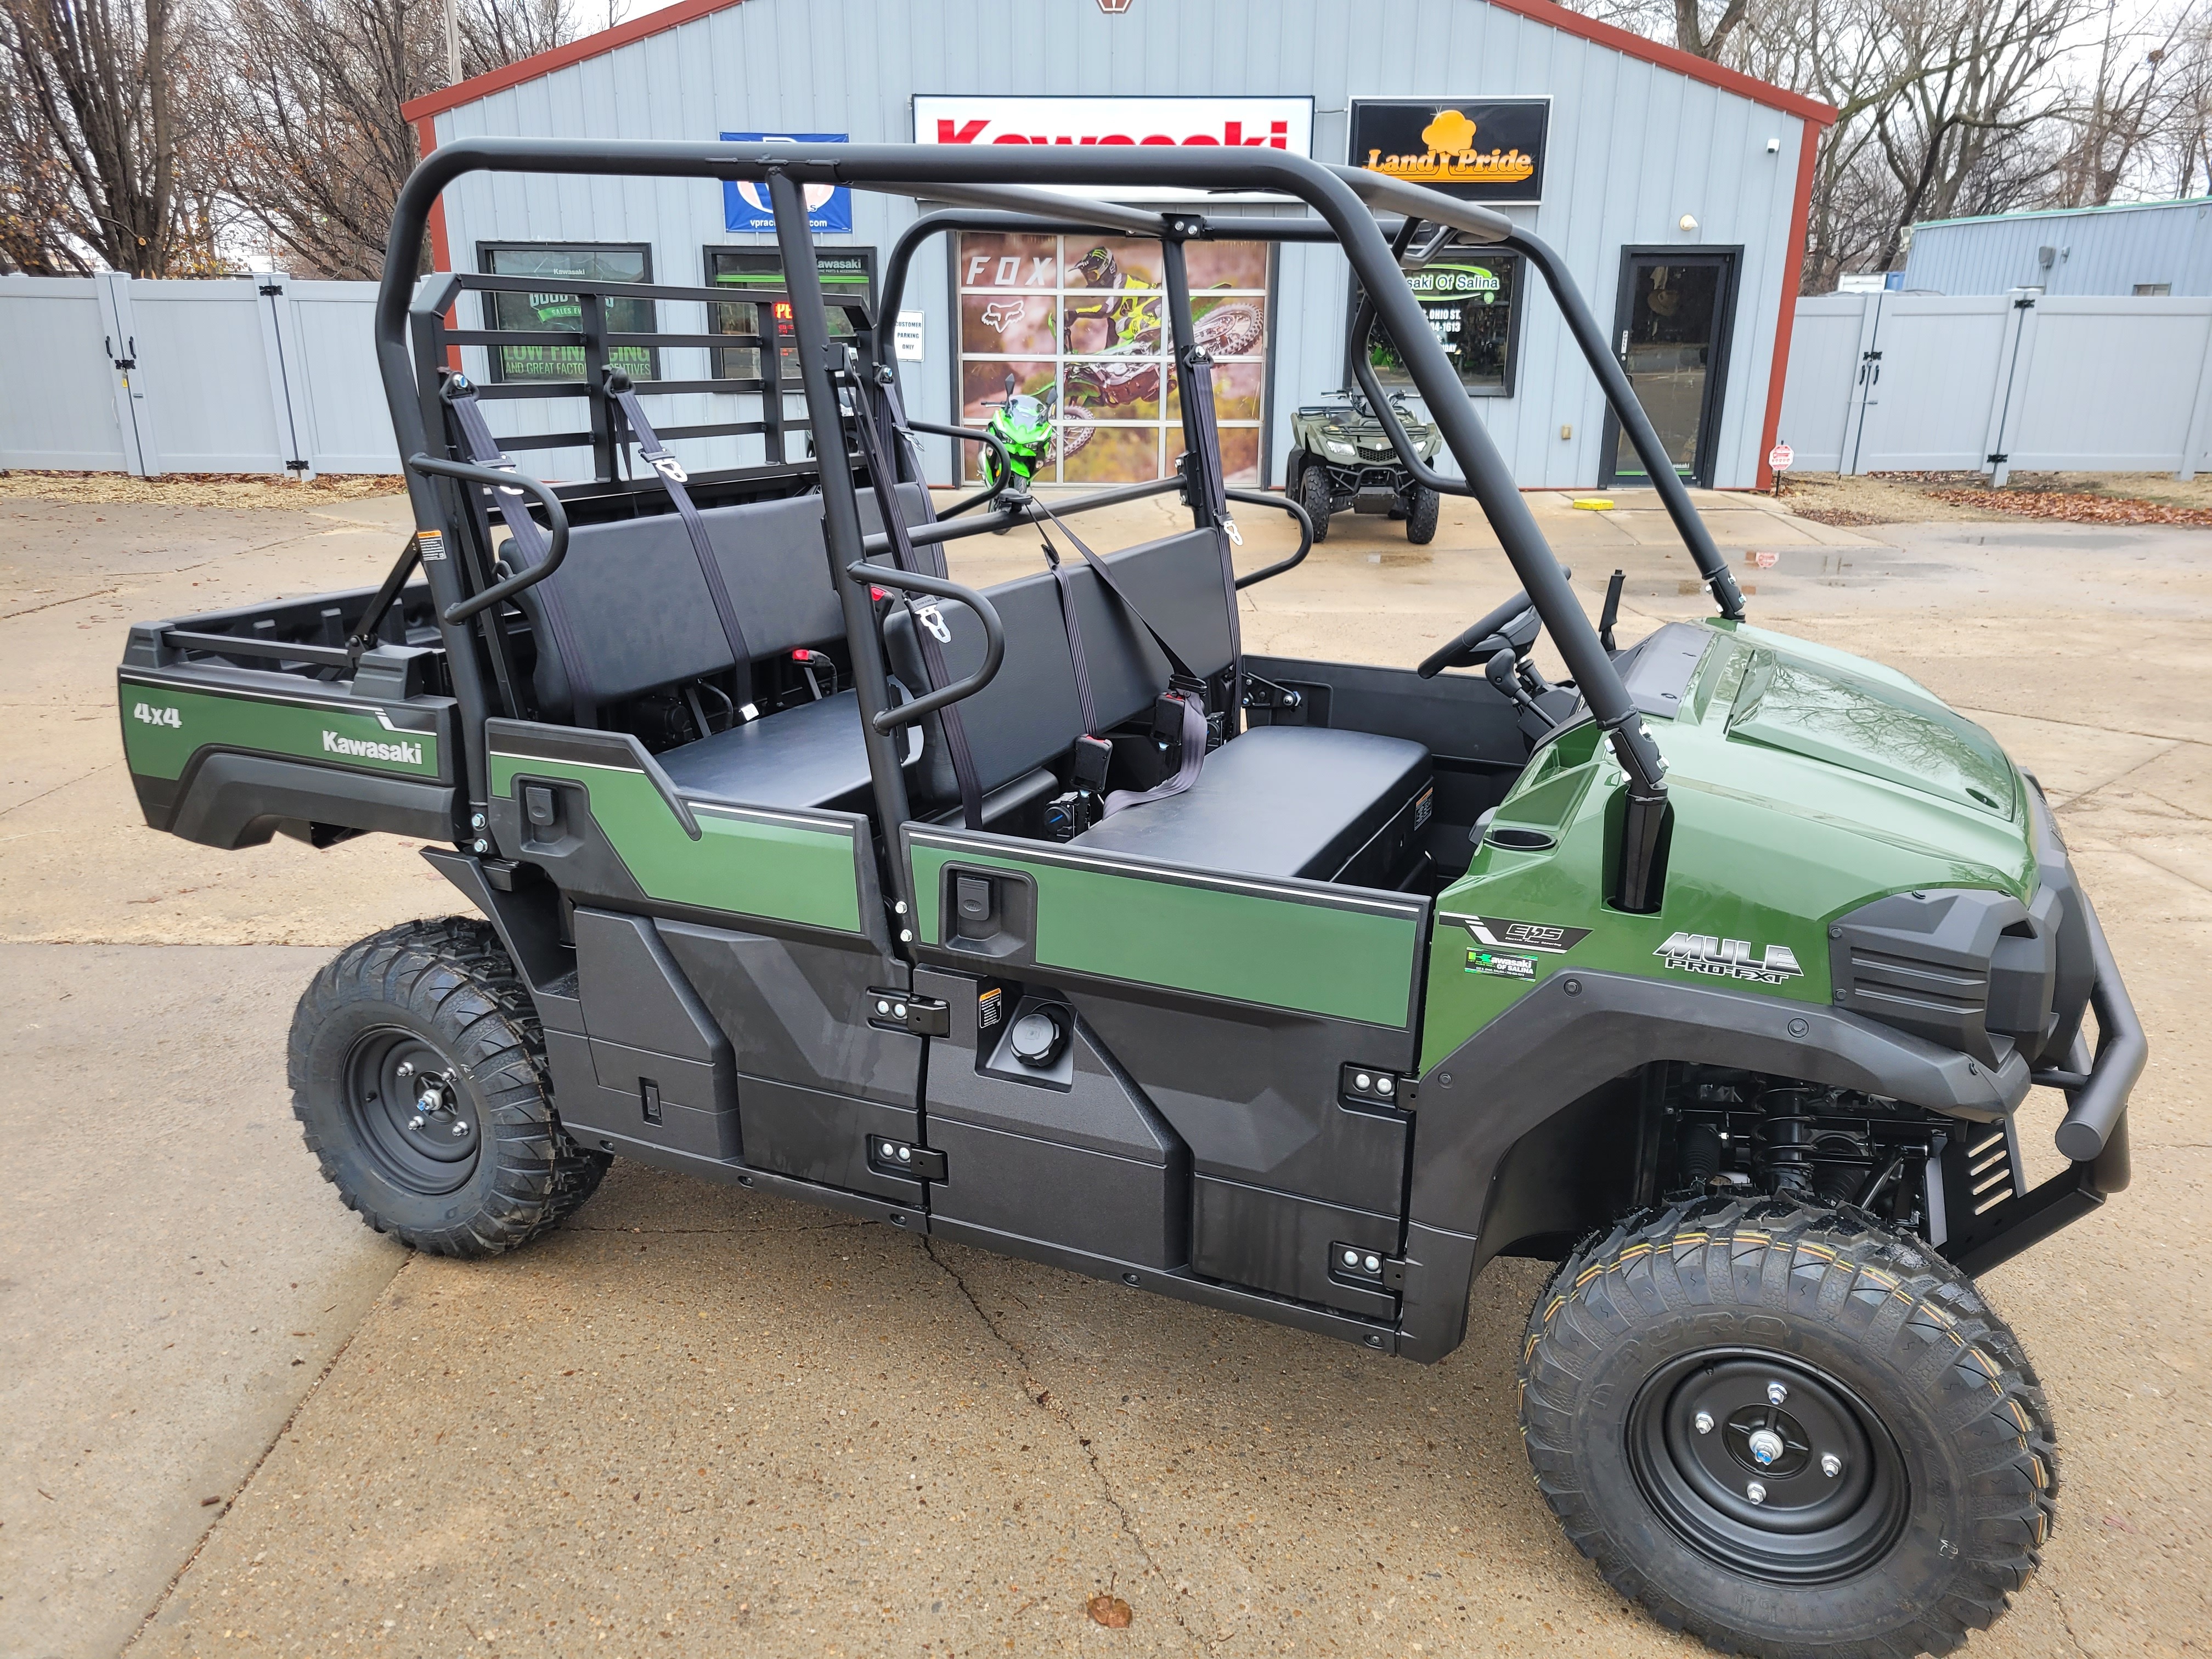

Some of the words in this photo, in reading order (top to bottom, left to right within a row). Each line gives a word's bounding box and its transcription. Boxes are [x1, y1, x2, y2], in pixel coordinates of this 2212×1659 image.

[1368, 149, 1437, 172] Land
[1454, 148, 1532, 172] Pride
[817, 259, 861, 269] awasaki
[966, 256, 1053, 286] FOX
[1407, 276, 1432, 289] saki
[1437, 276, 1453, 289] Of
[1457, 276, 1498, 289] Salina
[551, 308, 572, 316] SALES
[1429, 309, 1449, 320] OHIO
[1449, 309, 1462, 320] ST.
[503, 346, 543, 361] LOW
[506, 362, 524, 374] AND
[526, 363, 554, 375] GREAT
[556, 363, 587, 375] FACTO
[134, 703, 183, 728] 4x4
[322, 730, 422, 764] Kawasaki
[1652, 932, 1804, 977] MULE
[1507, 965, 1534, 974] SALINA
[1664, 957, 1790, 985] PRO-FXT
